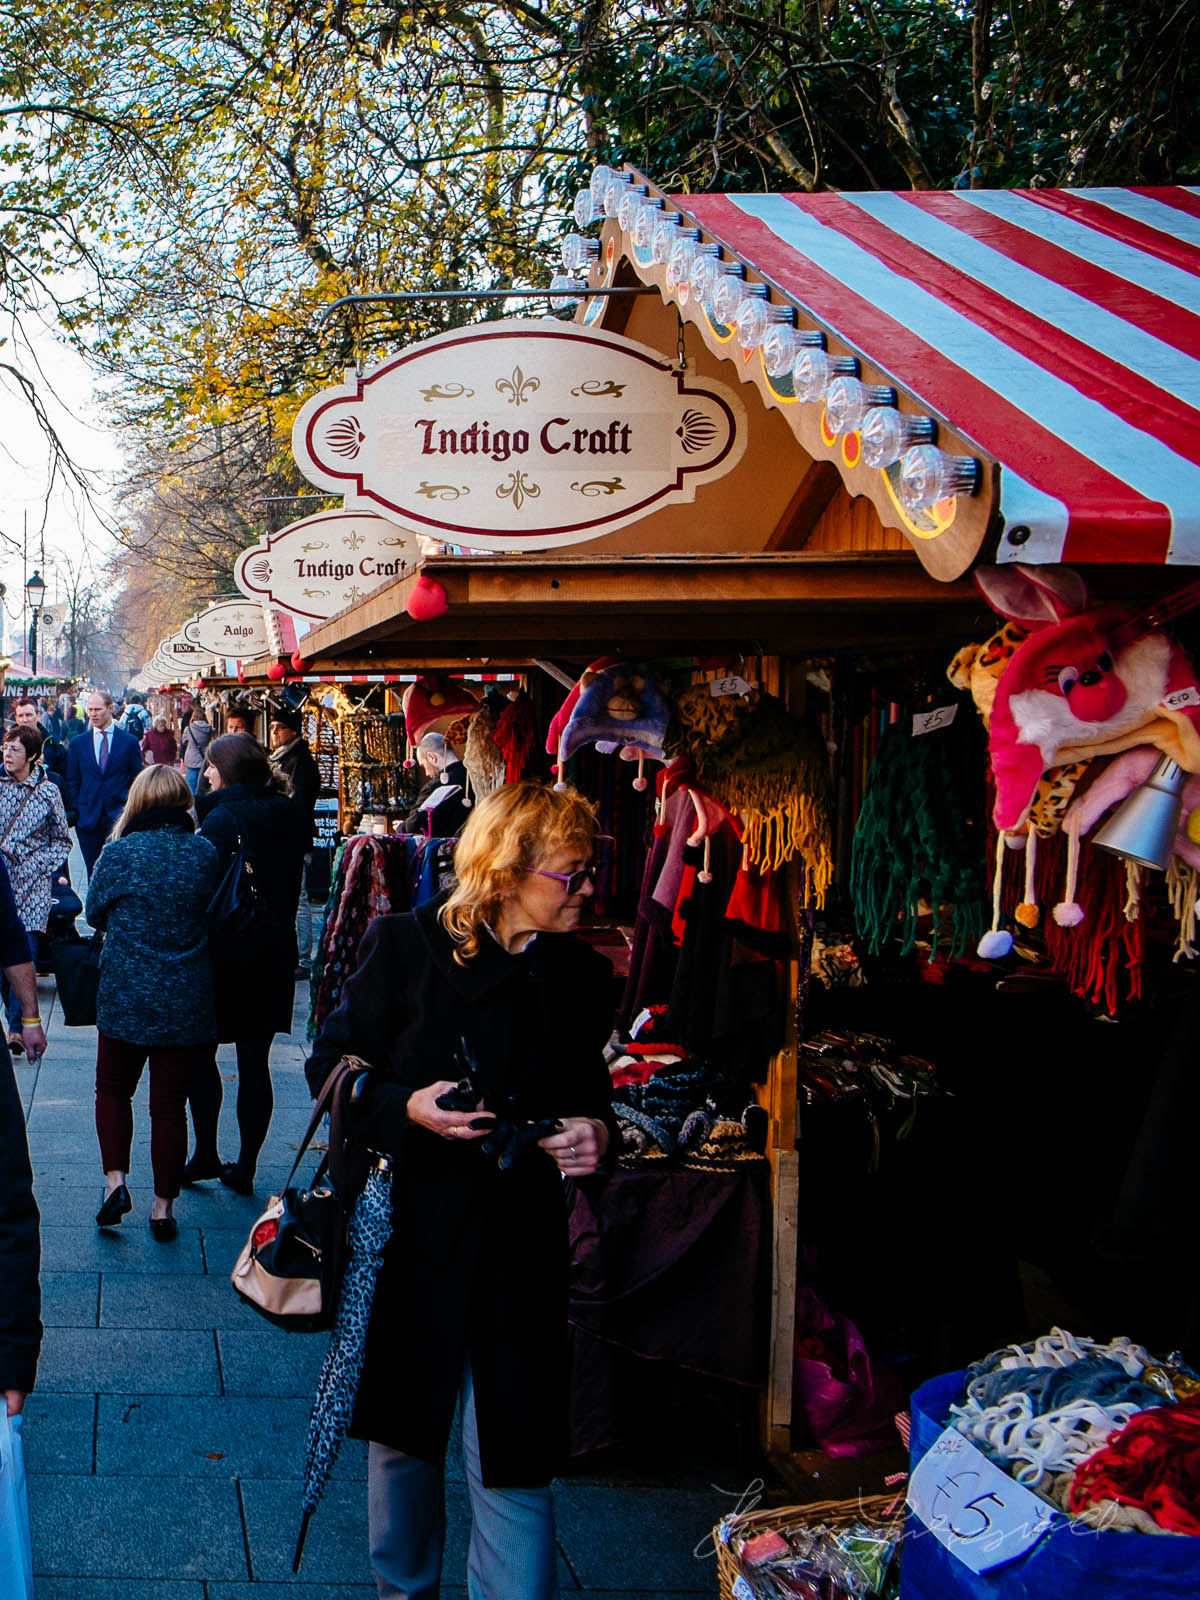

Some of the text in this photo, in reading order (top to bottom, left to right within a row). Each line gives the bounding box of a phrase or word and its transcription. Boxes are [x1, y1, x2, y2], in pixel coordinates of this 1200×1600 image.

[414, 417, 632, 461] Indigo Craft
[293, 556, 407, 581] Indigo Craft
